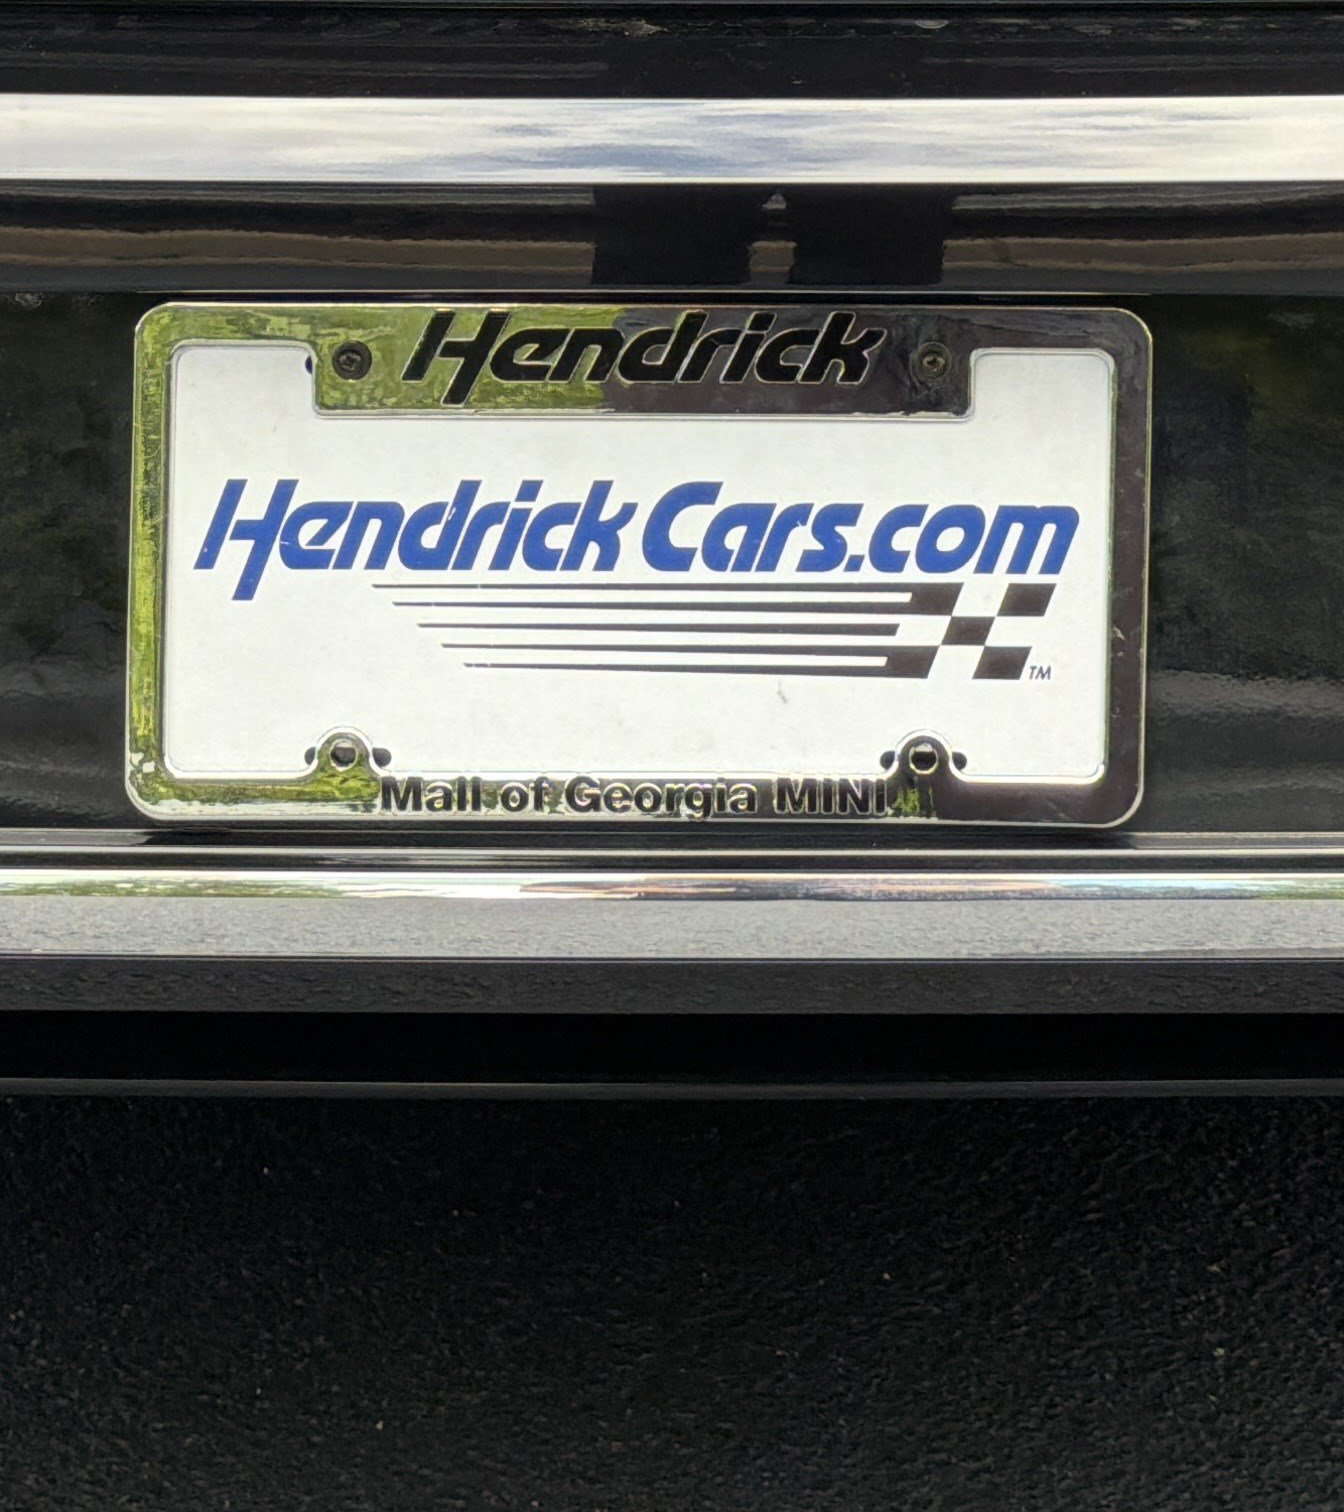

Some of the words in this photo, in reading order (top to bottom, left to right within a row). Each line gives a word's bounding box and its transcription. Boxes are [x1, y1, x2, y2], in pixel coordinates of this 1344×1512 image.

[400, 308, 888, 406] Hendrick
[379, 775, 483, 813] Mall
[499, 775, 551, 813] of
[564, 774, 758, 821] Georgia
[772, 777, 888, 816] MINI
